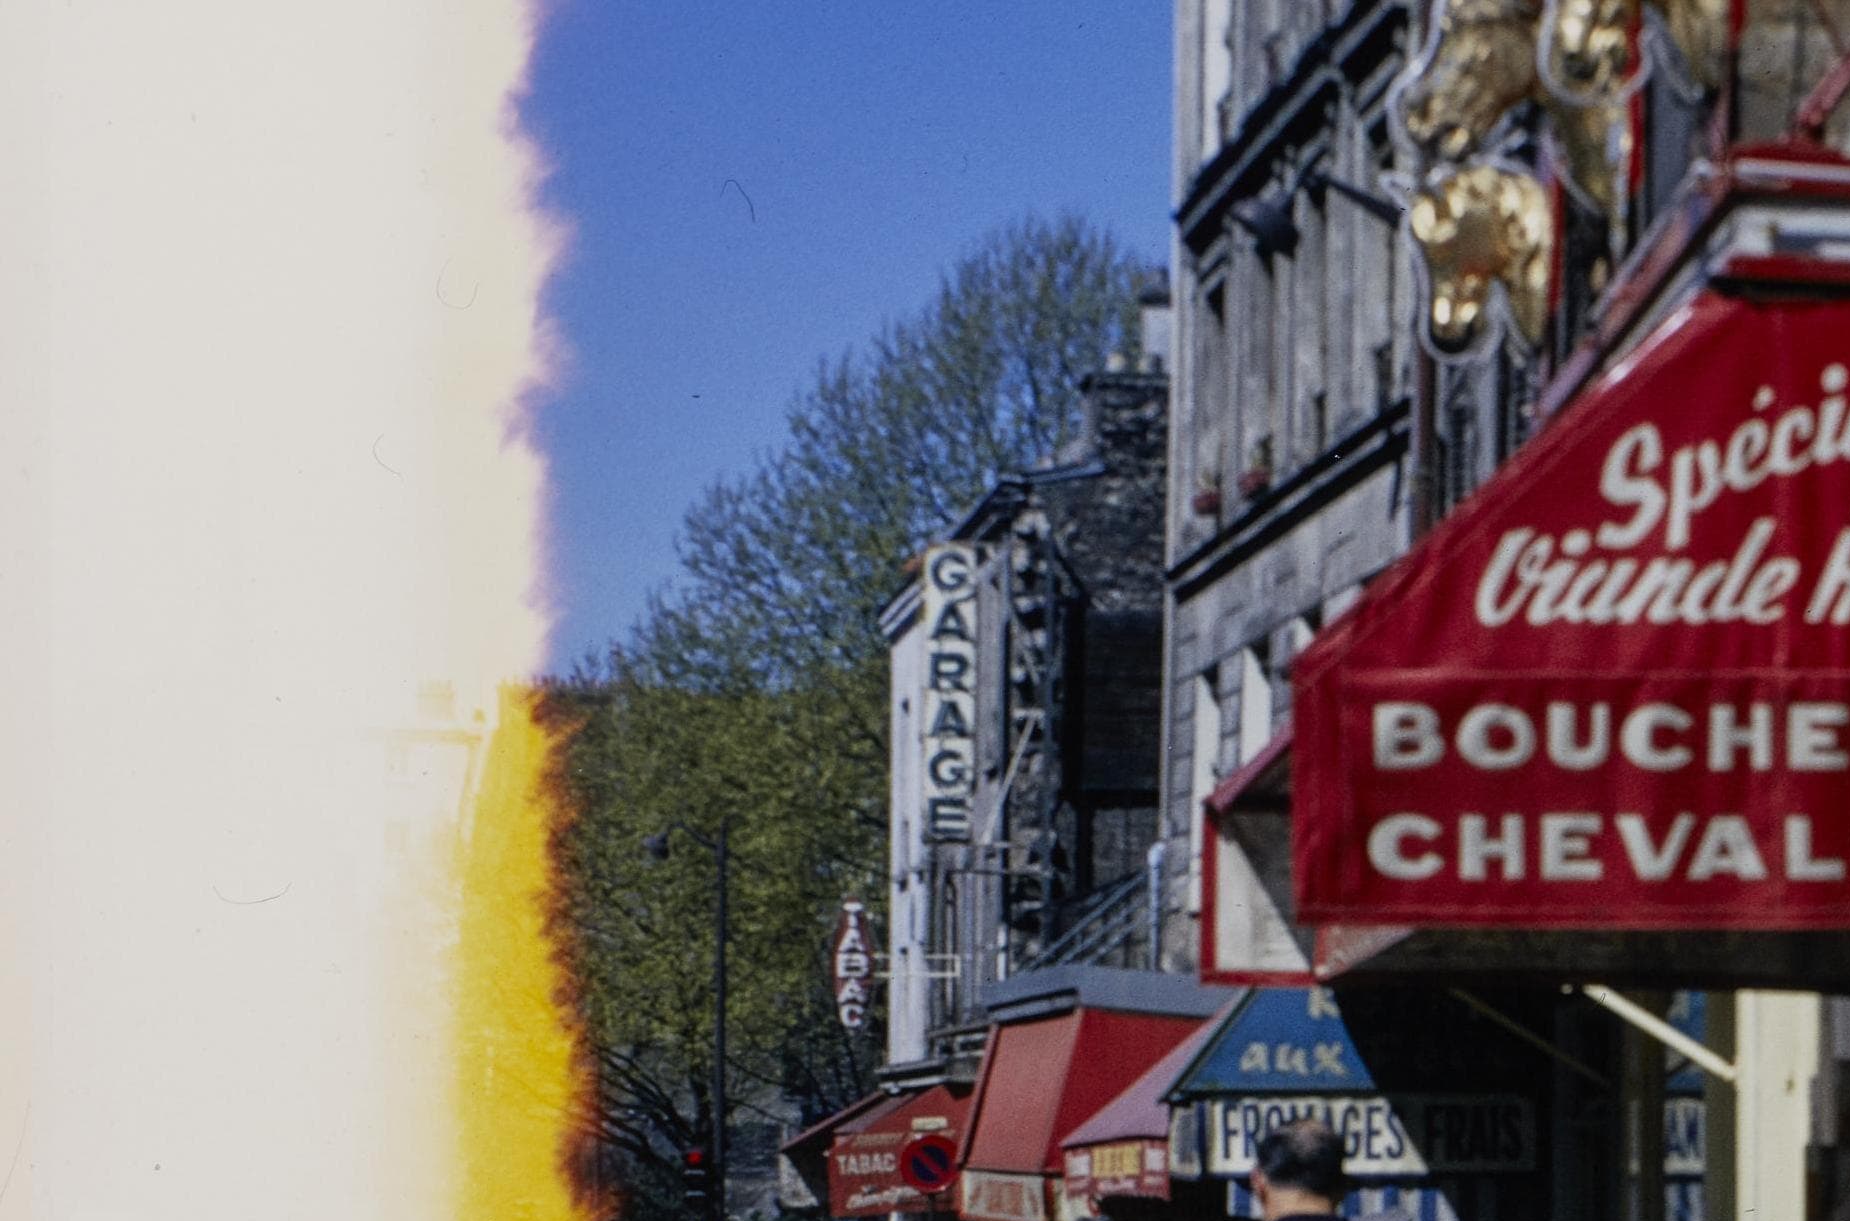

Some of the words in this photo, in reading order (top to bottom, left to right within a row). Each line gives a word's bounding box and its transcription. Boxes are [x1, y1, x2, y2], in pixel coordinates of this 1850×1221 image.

[1475, 516, 1801, 627] Viande
[929, 551, 970, 835] GARAGE
[836, 901, 869, 1028] TABAC
[836, 1152, 896, 1175] TABAC
[1425, 1104, 1522, 1161] FRAIS
